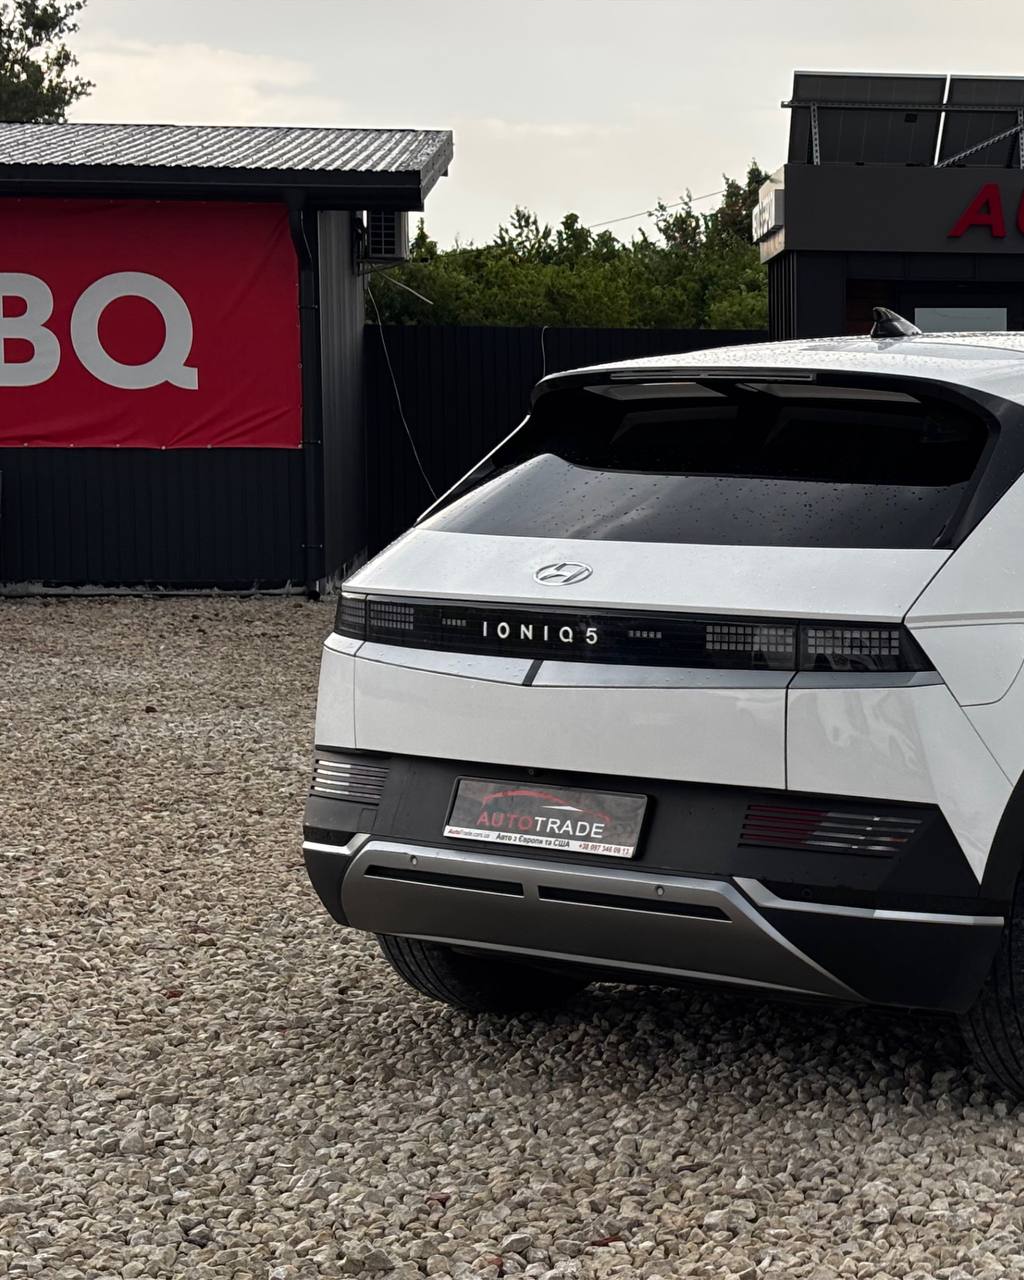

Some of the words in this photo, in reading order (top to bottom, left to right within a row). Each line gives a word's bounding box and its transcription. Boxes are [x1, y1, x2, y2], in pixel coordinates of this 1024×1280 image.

[476, 811, 605, 838] AUTOTRADE
[495, 832, 512, 842] Авто
[518, 836, 544, 846] Європи
[544, 838, 553, 846] та
[553, 838, 570, 848] США
[590, 843, 601, 852] 097
